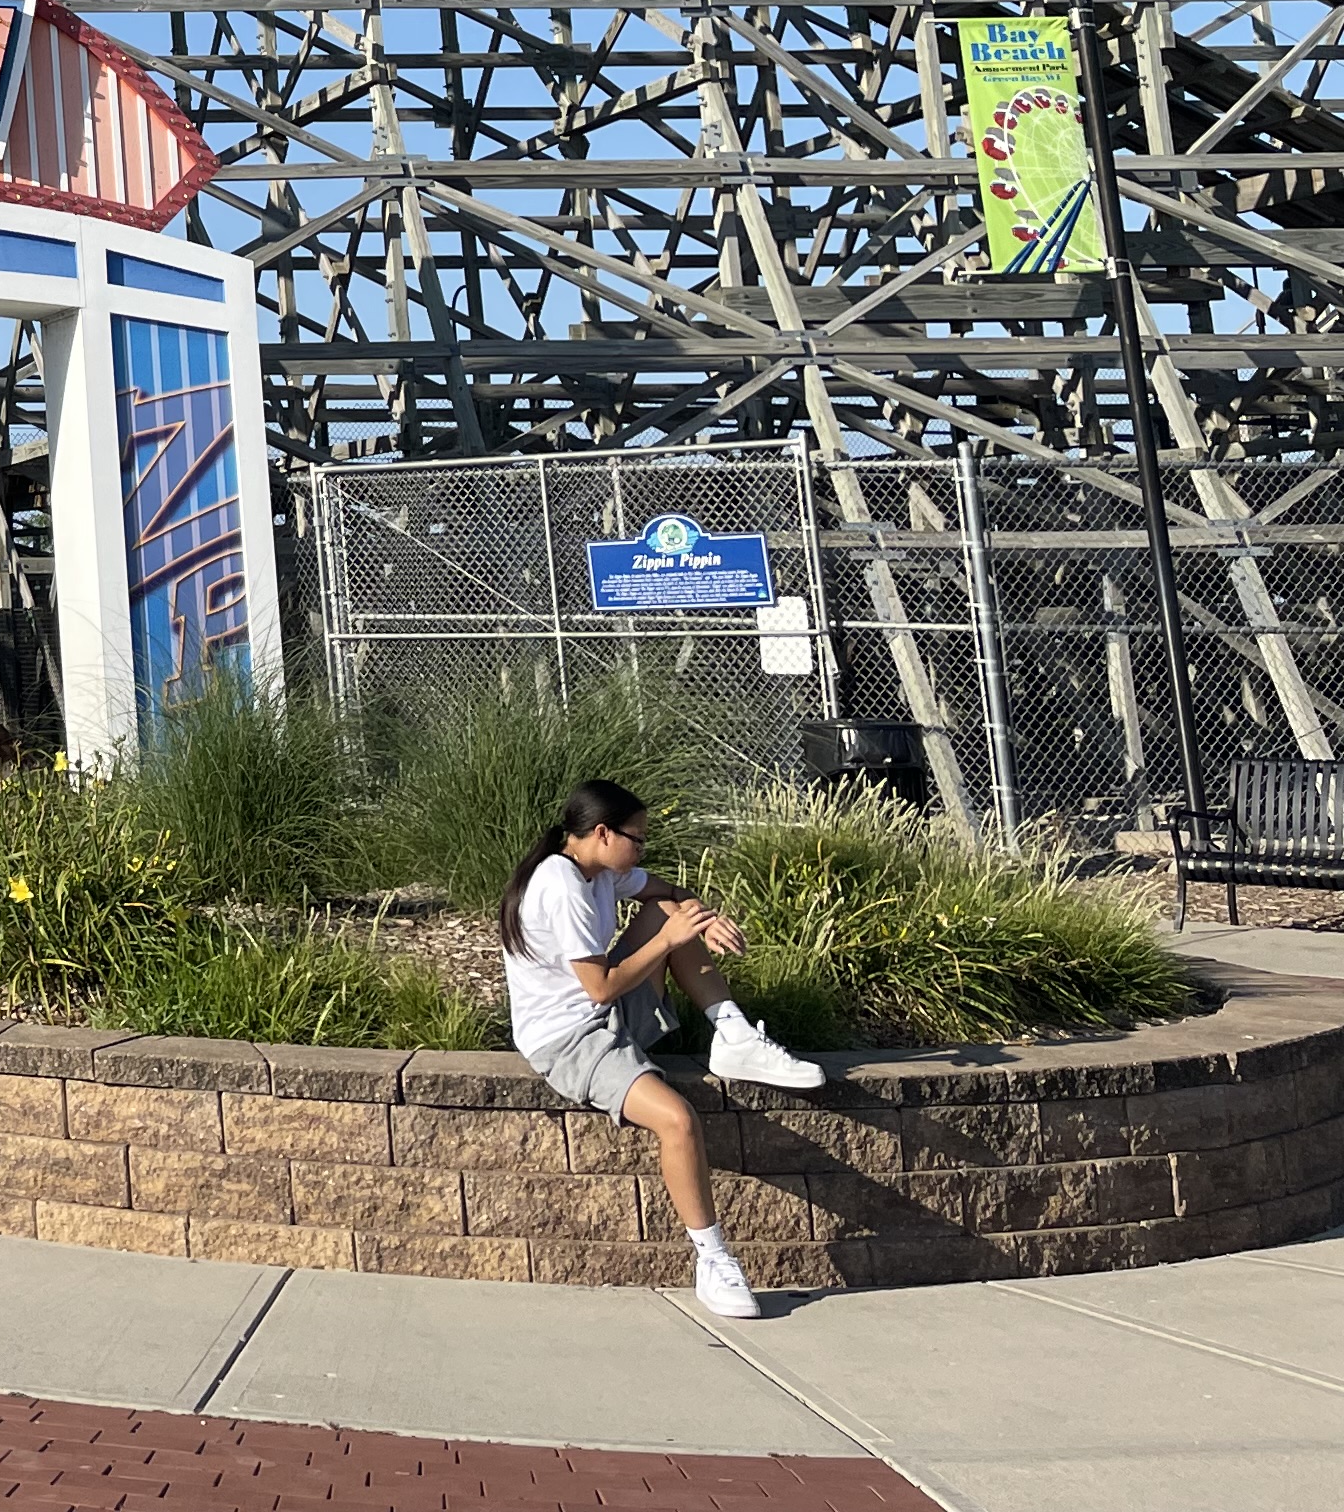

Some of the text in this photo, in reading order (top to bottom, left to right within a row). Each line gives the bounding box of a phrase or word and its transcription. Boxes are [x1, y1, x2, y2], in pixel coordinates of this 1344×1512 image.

[986, 23, 1040, 48] Bay
[970, 41, 1067, 62] Beach
[1042, 63, 1068, 71] Park
[631, 552, 722, 571] Zippin Pippin
